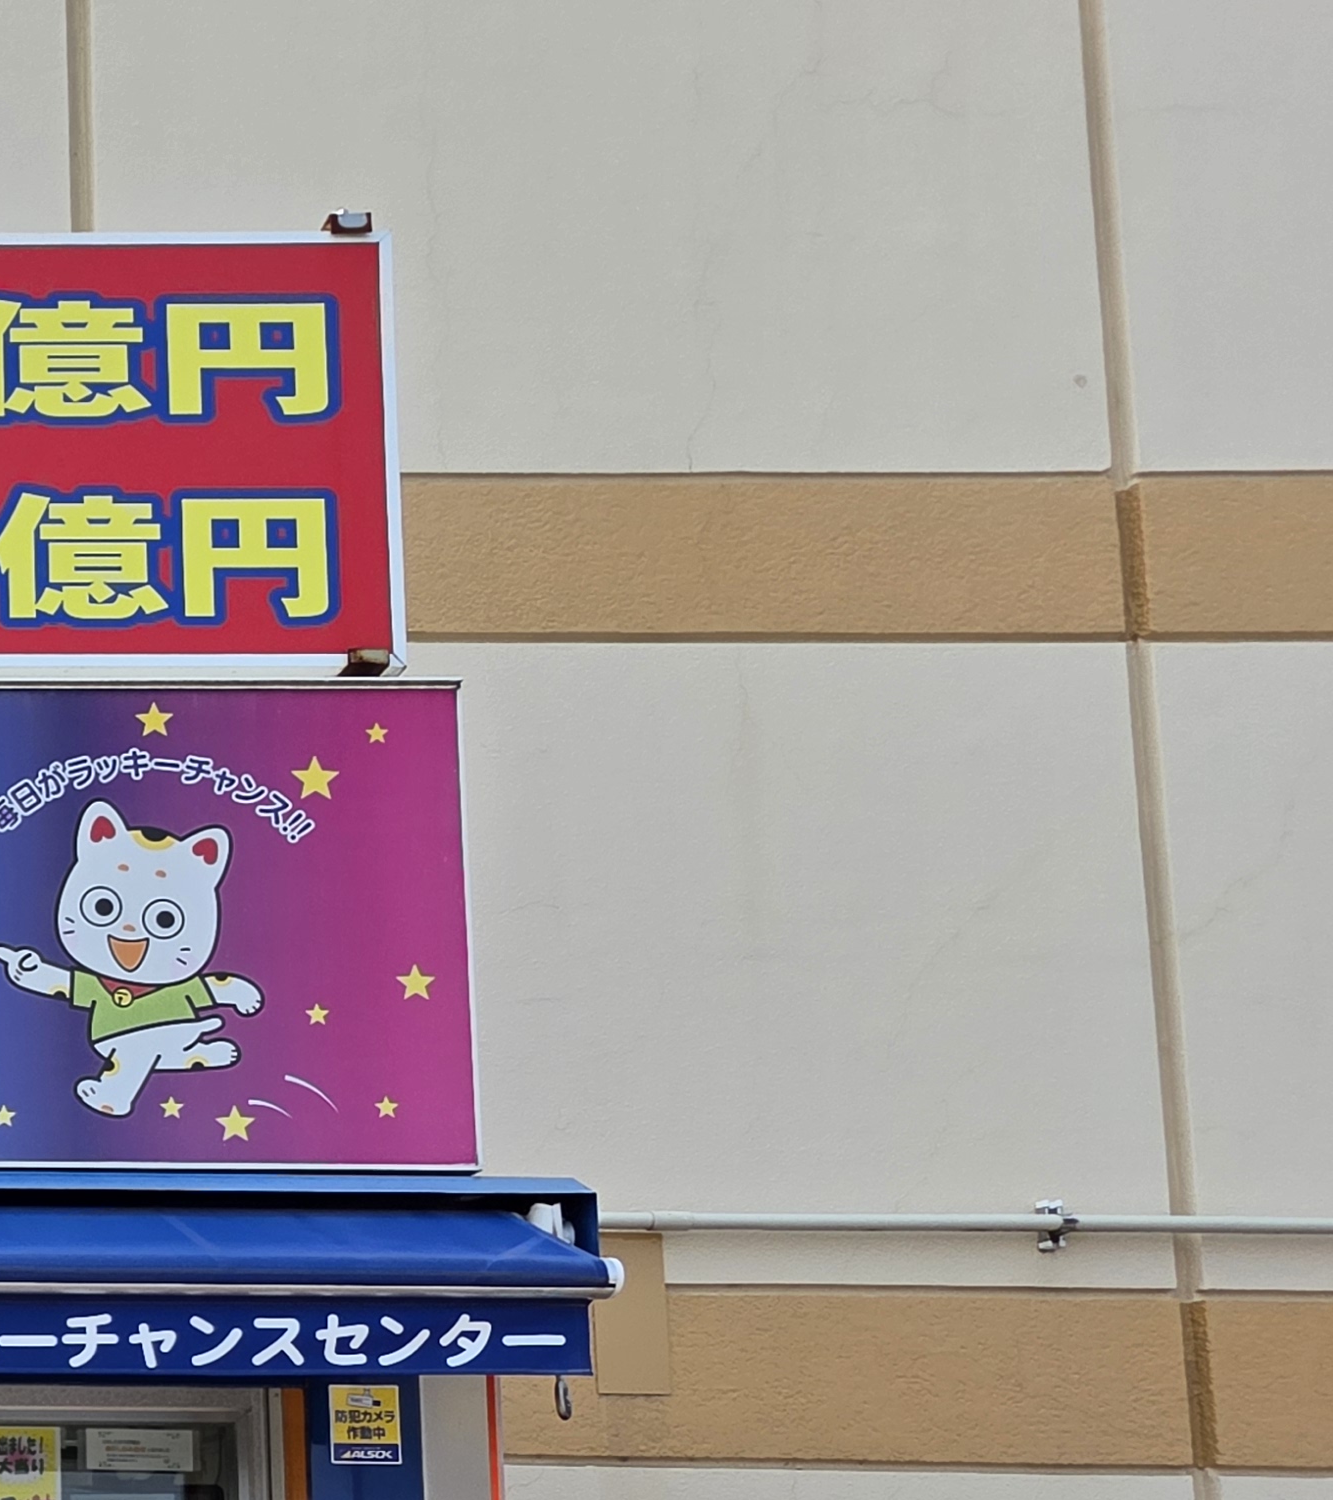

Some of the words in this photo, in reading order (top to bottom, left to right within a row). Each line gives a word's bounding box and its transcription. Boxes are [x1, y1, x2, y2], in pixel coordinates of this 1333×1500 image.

[335, 1409, 395, 1424] 防犯カメラ
[346, 1426, 386, 1440] 作動中
[351, 1450, 394, 1459] ALSOK
